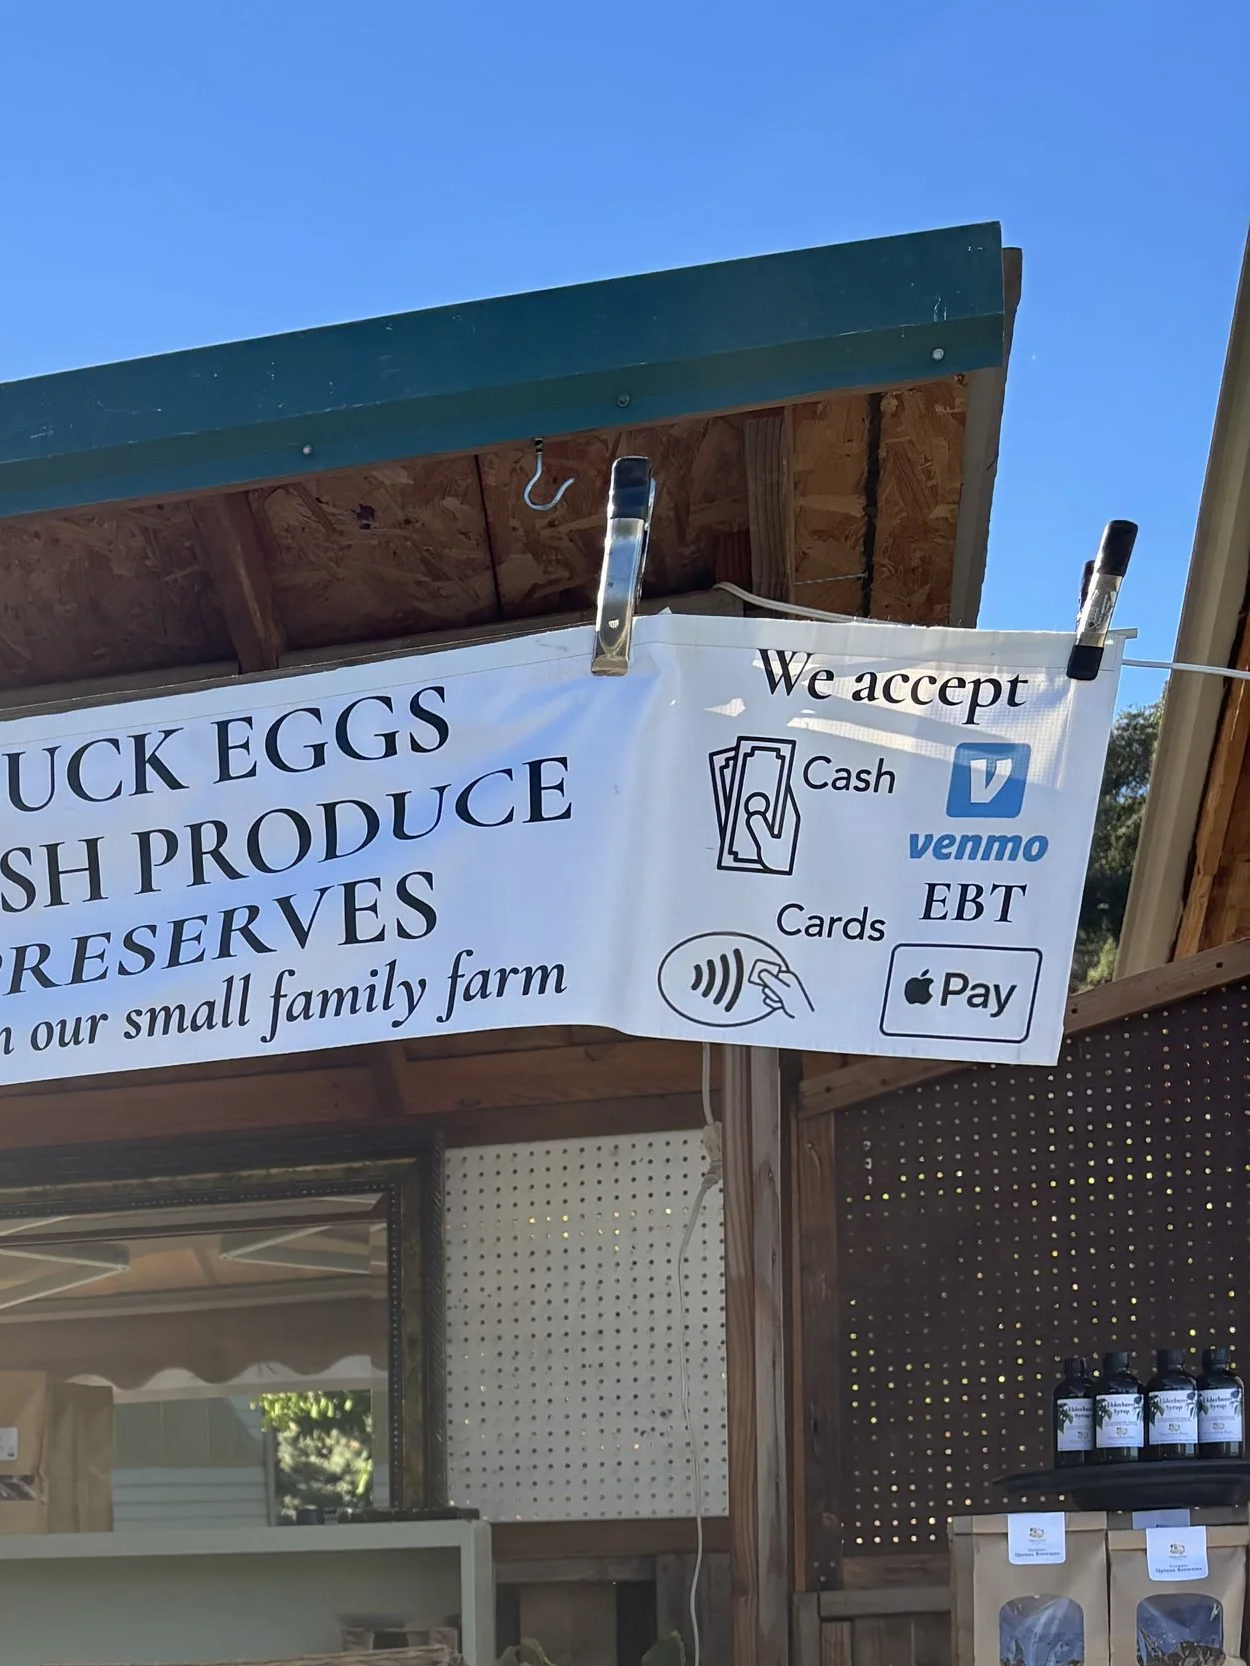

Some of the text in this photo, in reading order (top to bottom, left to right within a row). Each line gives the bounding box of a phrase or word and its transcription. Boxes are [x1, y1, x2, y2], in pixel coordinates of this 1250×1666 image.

[755, 648, 1030, 726] We accept
[210, 685, 451, 785] EGGS
[802, 755, 897, 795] Cash
[130, 756, 574, 896] PRODUCE
[909, 832, 1049, 864] venmo
[776, 902, 887, 942] Cards
[918, 881, 1028, 924] EBT
[30, 1013, 109, 1052] our
[123, 972, 252, 1040] small
[259, 958, 428, 1044] family
[435, 947, 569, 1024] farm
[940, 972, 1018, 1019] Pay
